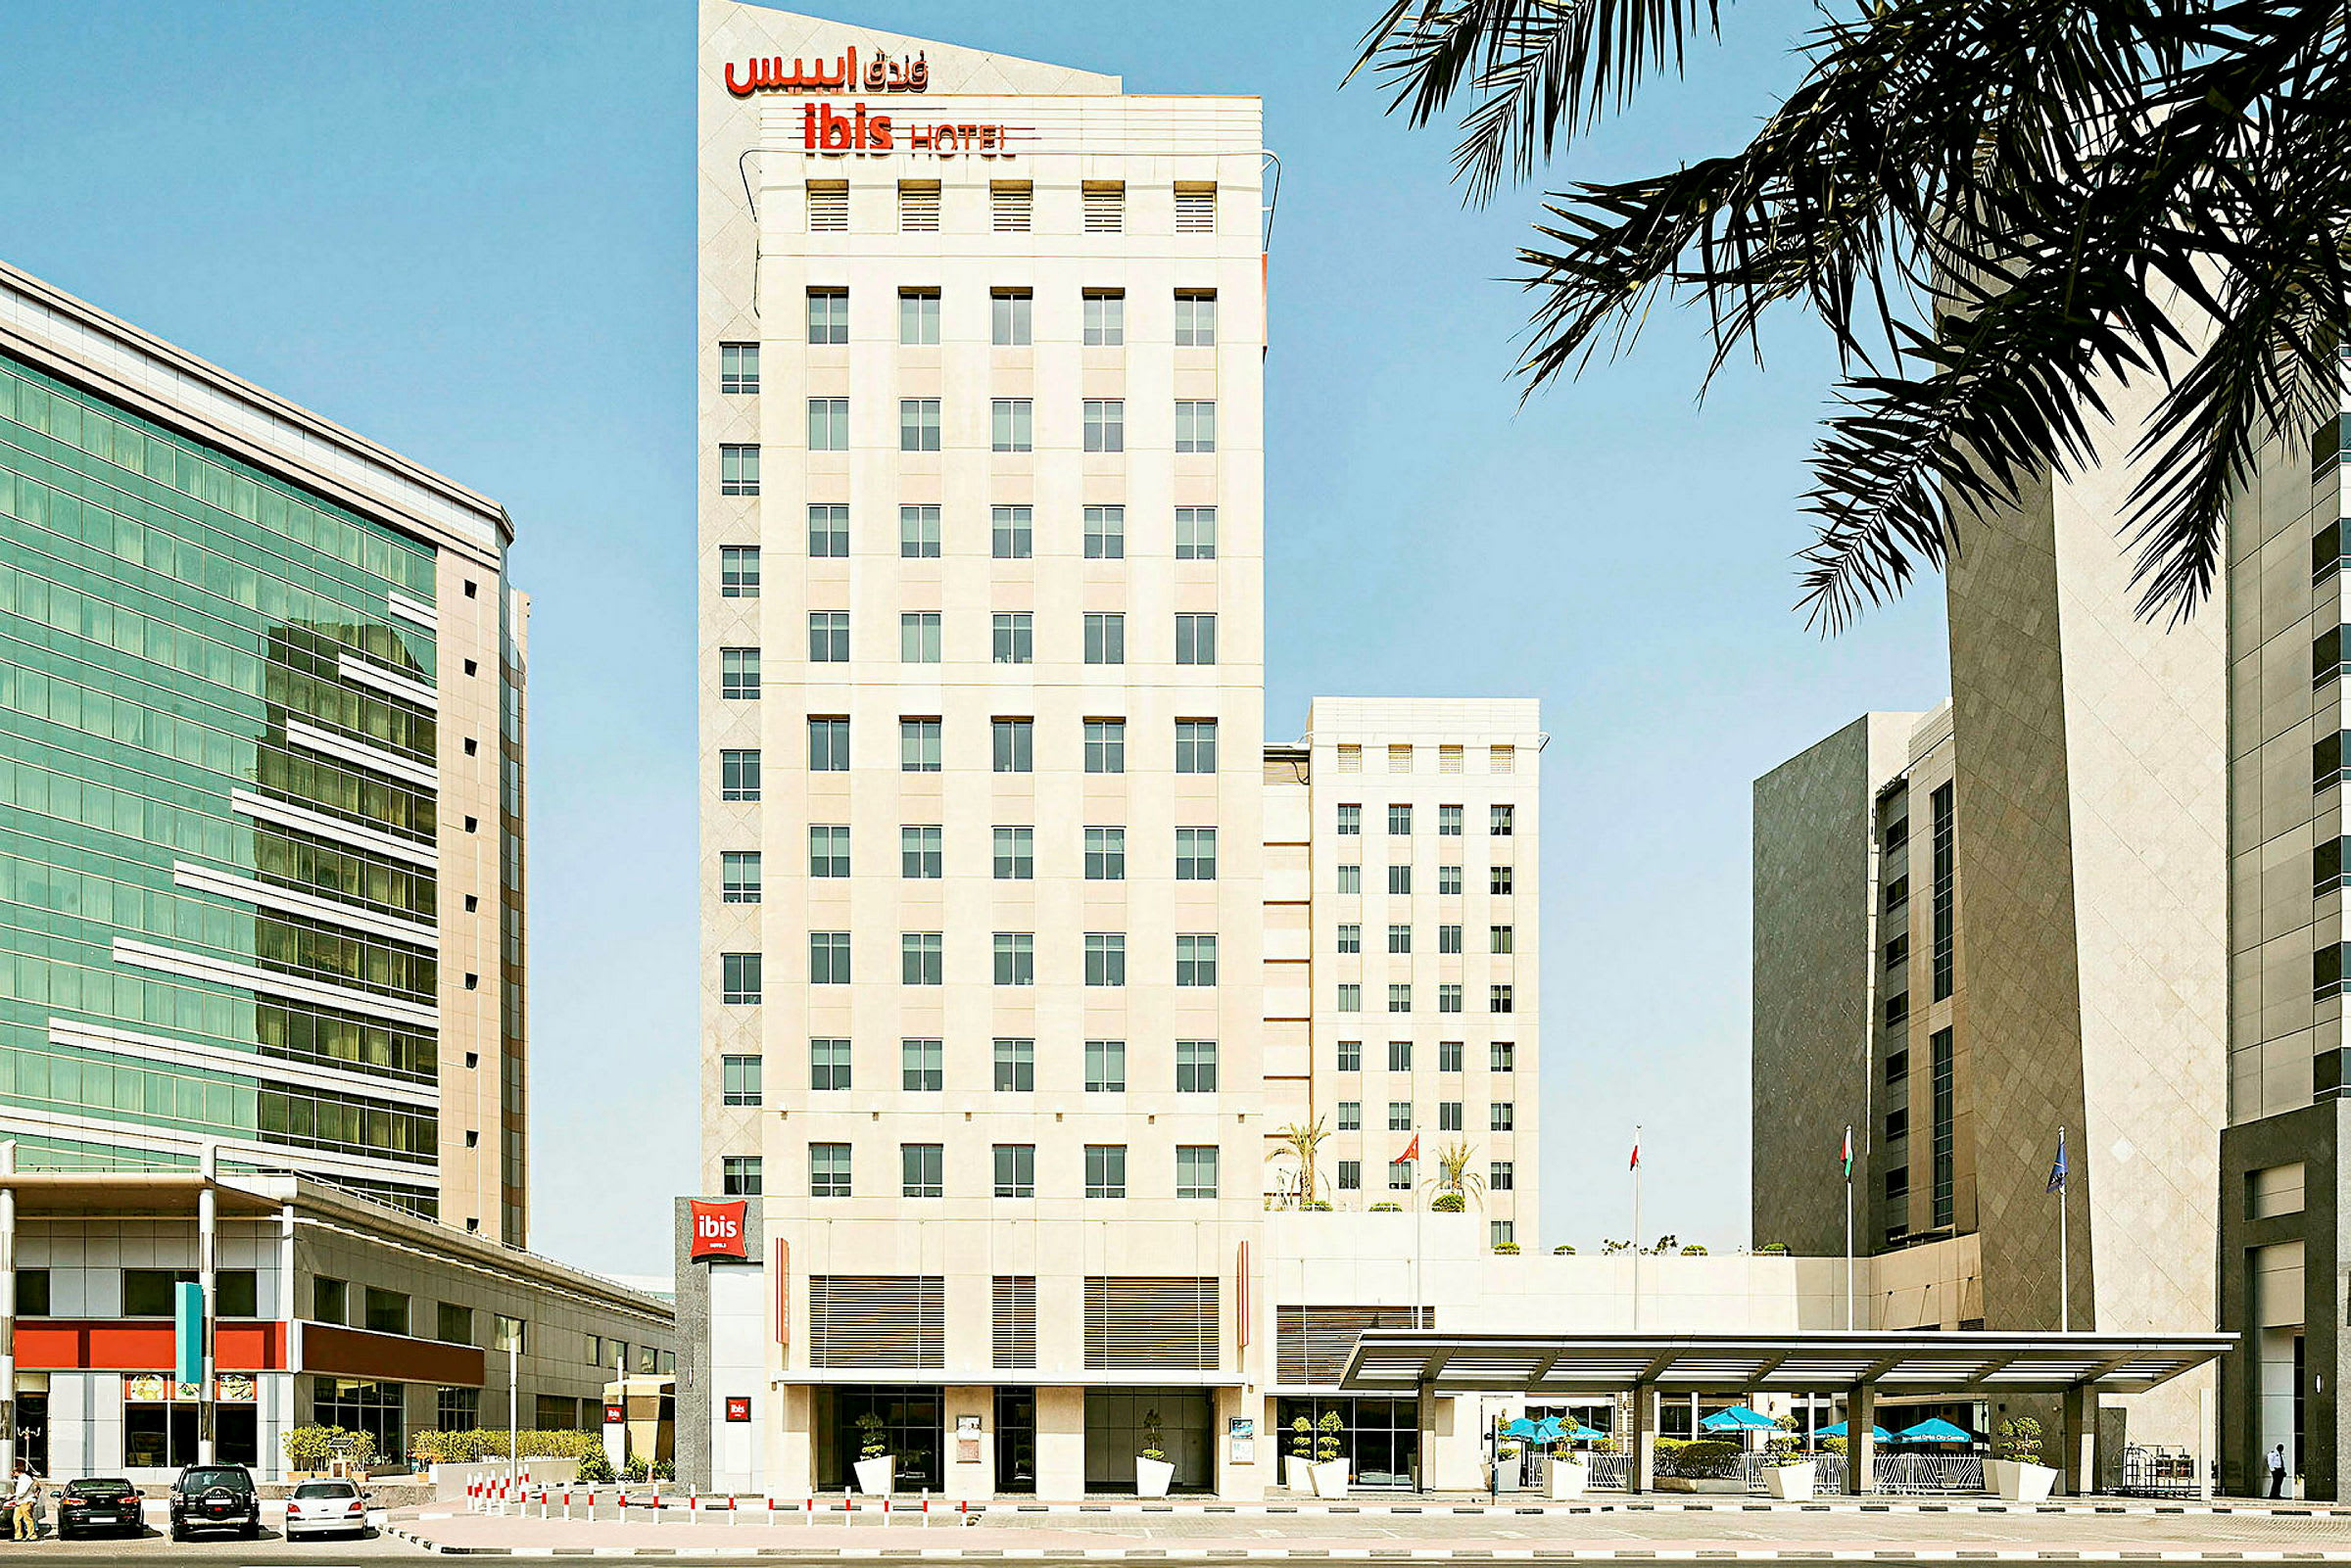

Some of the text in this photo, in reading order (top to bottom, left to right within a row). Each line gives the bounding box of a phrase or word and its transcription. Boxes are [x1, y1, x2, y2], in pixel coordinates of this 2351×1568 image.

[863, 50, 929, 93] فندق
[804, 103, 1016, 157] ibis HOTEL
[698, 1214, 738, 1238] ibis
